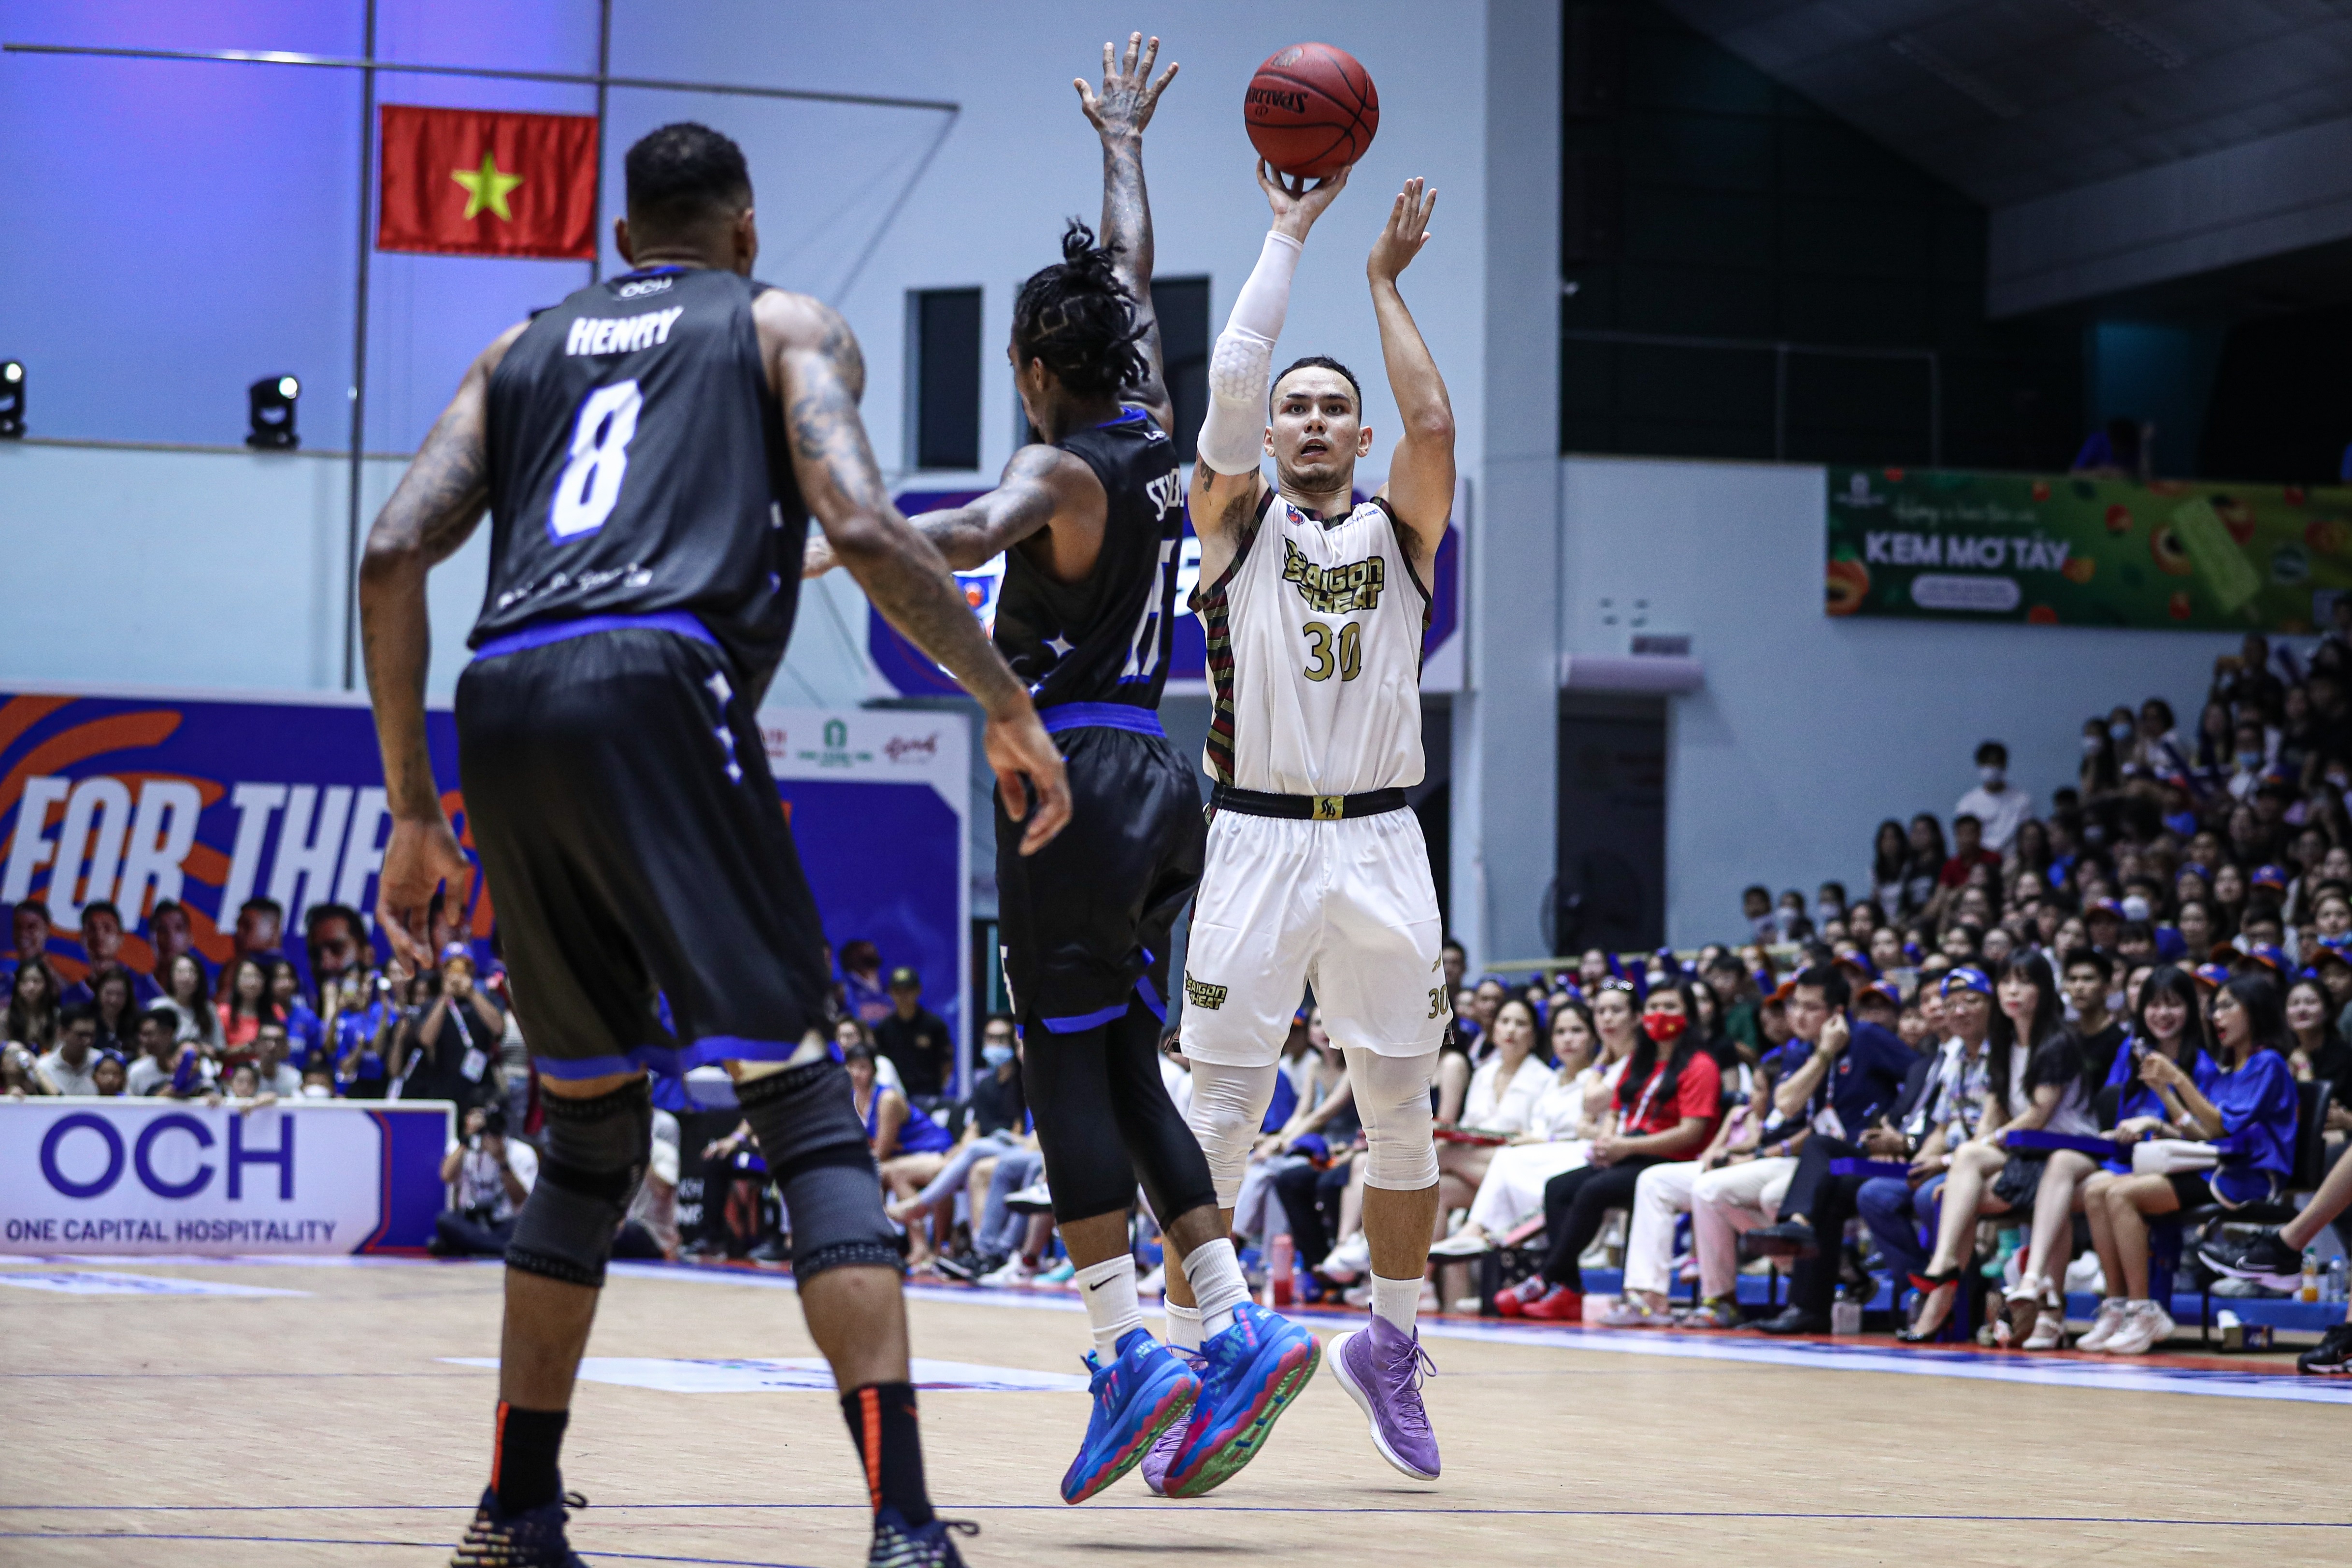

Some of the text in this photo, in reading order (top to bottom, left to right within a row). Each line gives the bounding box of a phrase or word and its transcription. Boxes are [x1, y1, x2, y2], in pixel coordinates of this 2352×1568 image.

[566, 305, 684, 357] HENRY
[546, 378, 645, 547] 8
[1865, 531, 1942, 566] KEM
[1282, 554, 1385, 592] SAIGON
[1300, 582, 1385, 614] HEAT
[1303, 621, 1362, 682] 30
[1, 776, 202, 932] FOR
[1186, 978, 1228, 999] SAIGON
[1190, 992, 1224, 1010] HEAT
[1428, 984, 1448, 1019] 30
[39, 1111, 295, 1201] OCH
[6, 1219, 337, 1243] ONE CAPITAL HOSPITALITY
